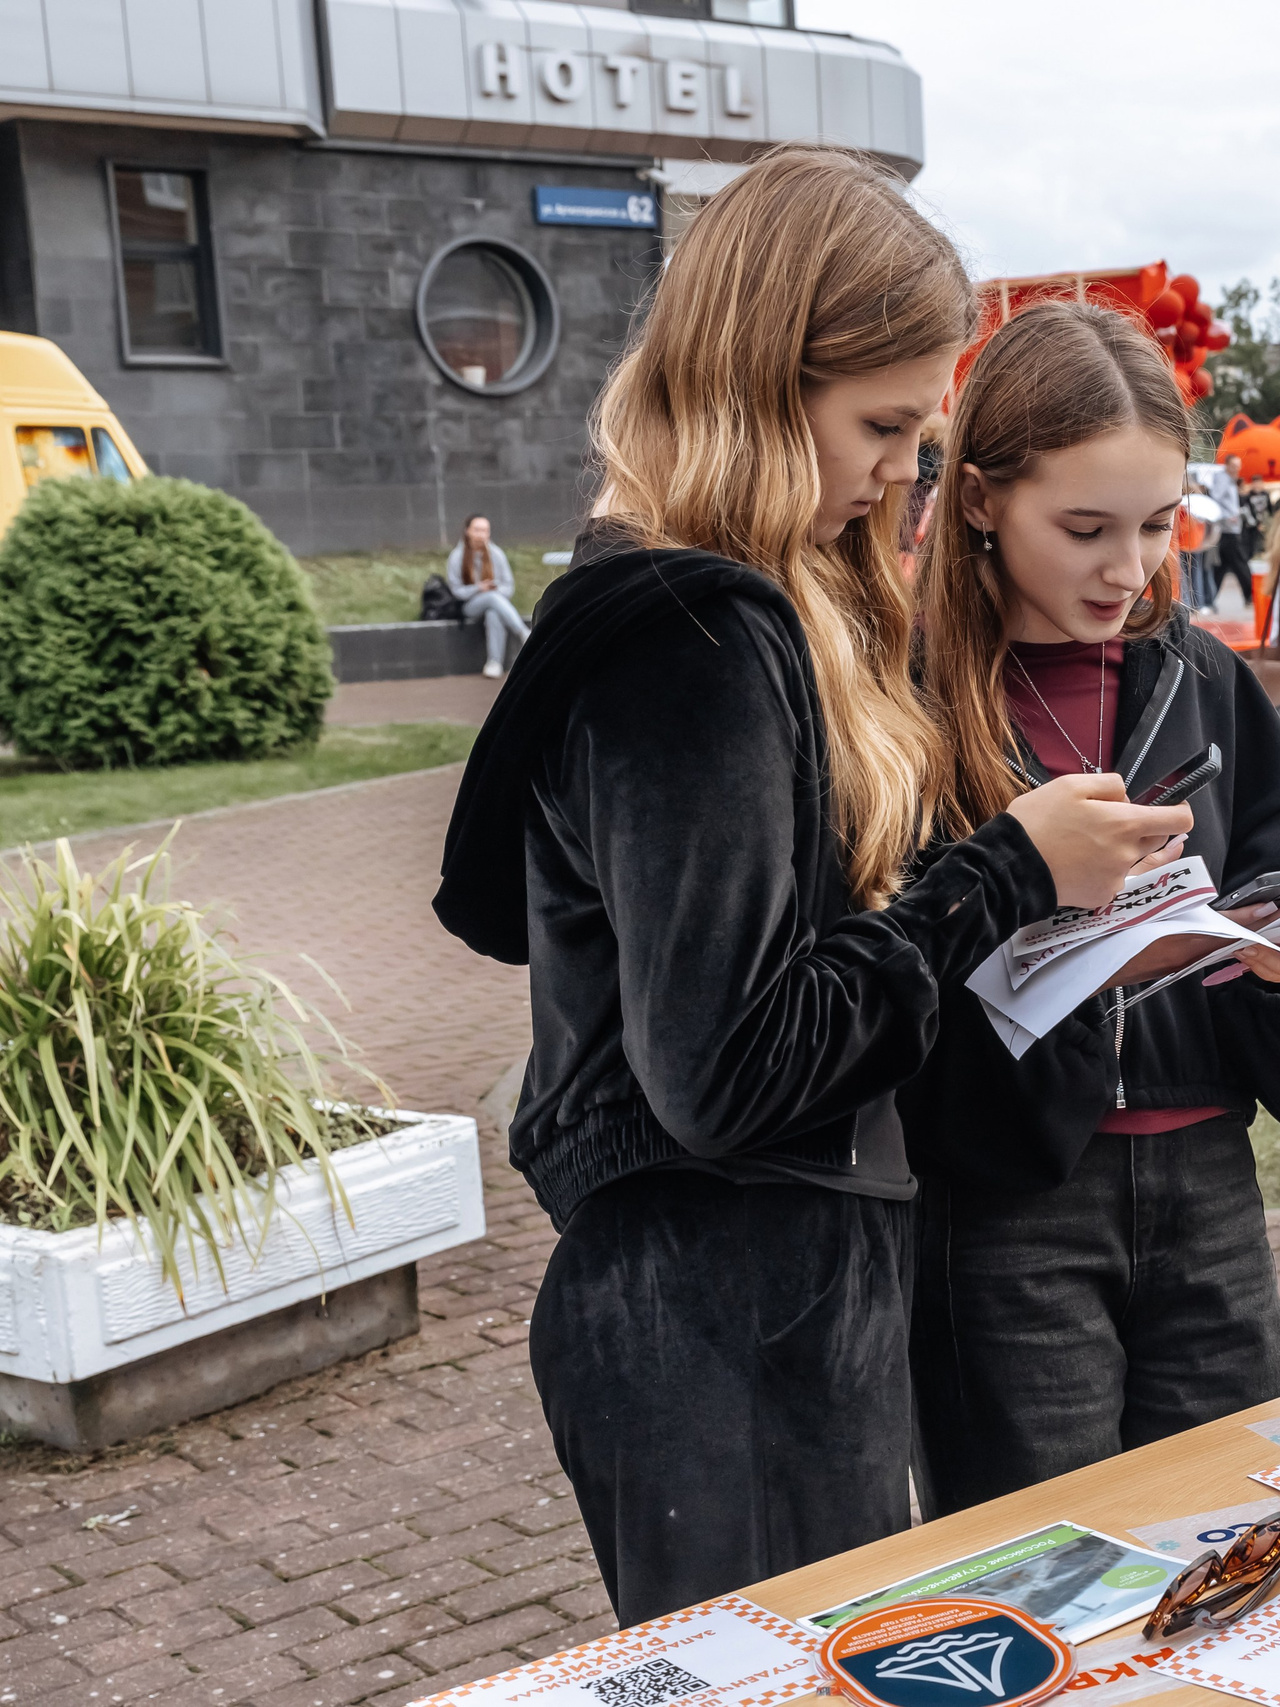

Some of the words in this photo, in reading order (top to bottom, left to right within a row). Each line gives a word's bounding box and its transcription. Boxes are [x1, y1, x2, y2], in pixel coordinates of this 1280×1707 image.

[479, 43, 752, 118] HOTEL
[627, 195, 654, 223] 62
[1052, 884, 1188, 926] КНИЖКА
[1025, 923, 1078, 942] Штаба
[987, 1538, 1057, 1566] Российские
[880, 1618, 899, 1628] ГОДУ
[887, 1608, 960, 1632] КАЛИНИНГРАДСКОЙ
[902, 1610, 973, 1632] ОБРАЗОВАТЕЛЬНОЙ
[934, 1619, 956, 1629] ШТАБ
[956, 1610, 989, 1624] ЛУЧШИЙ
[847, 1628, 902, 1647] ОРГАНИЗАЦИИ
[851, 1628, 887, 1640] ОБЛАСТИ
[877, 1625, 934, 1645] СТУДЕНЧЕСКИХ
[606, 1629, 717, 1670] ЗАПАДНОГО
[840, 1641, 877, 1654] ОТРЯДОВ
[533, 1636, 666, 1683] РАНХИГС
[505, 1669, 602, 1702] ФИЛИАЛА
